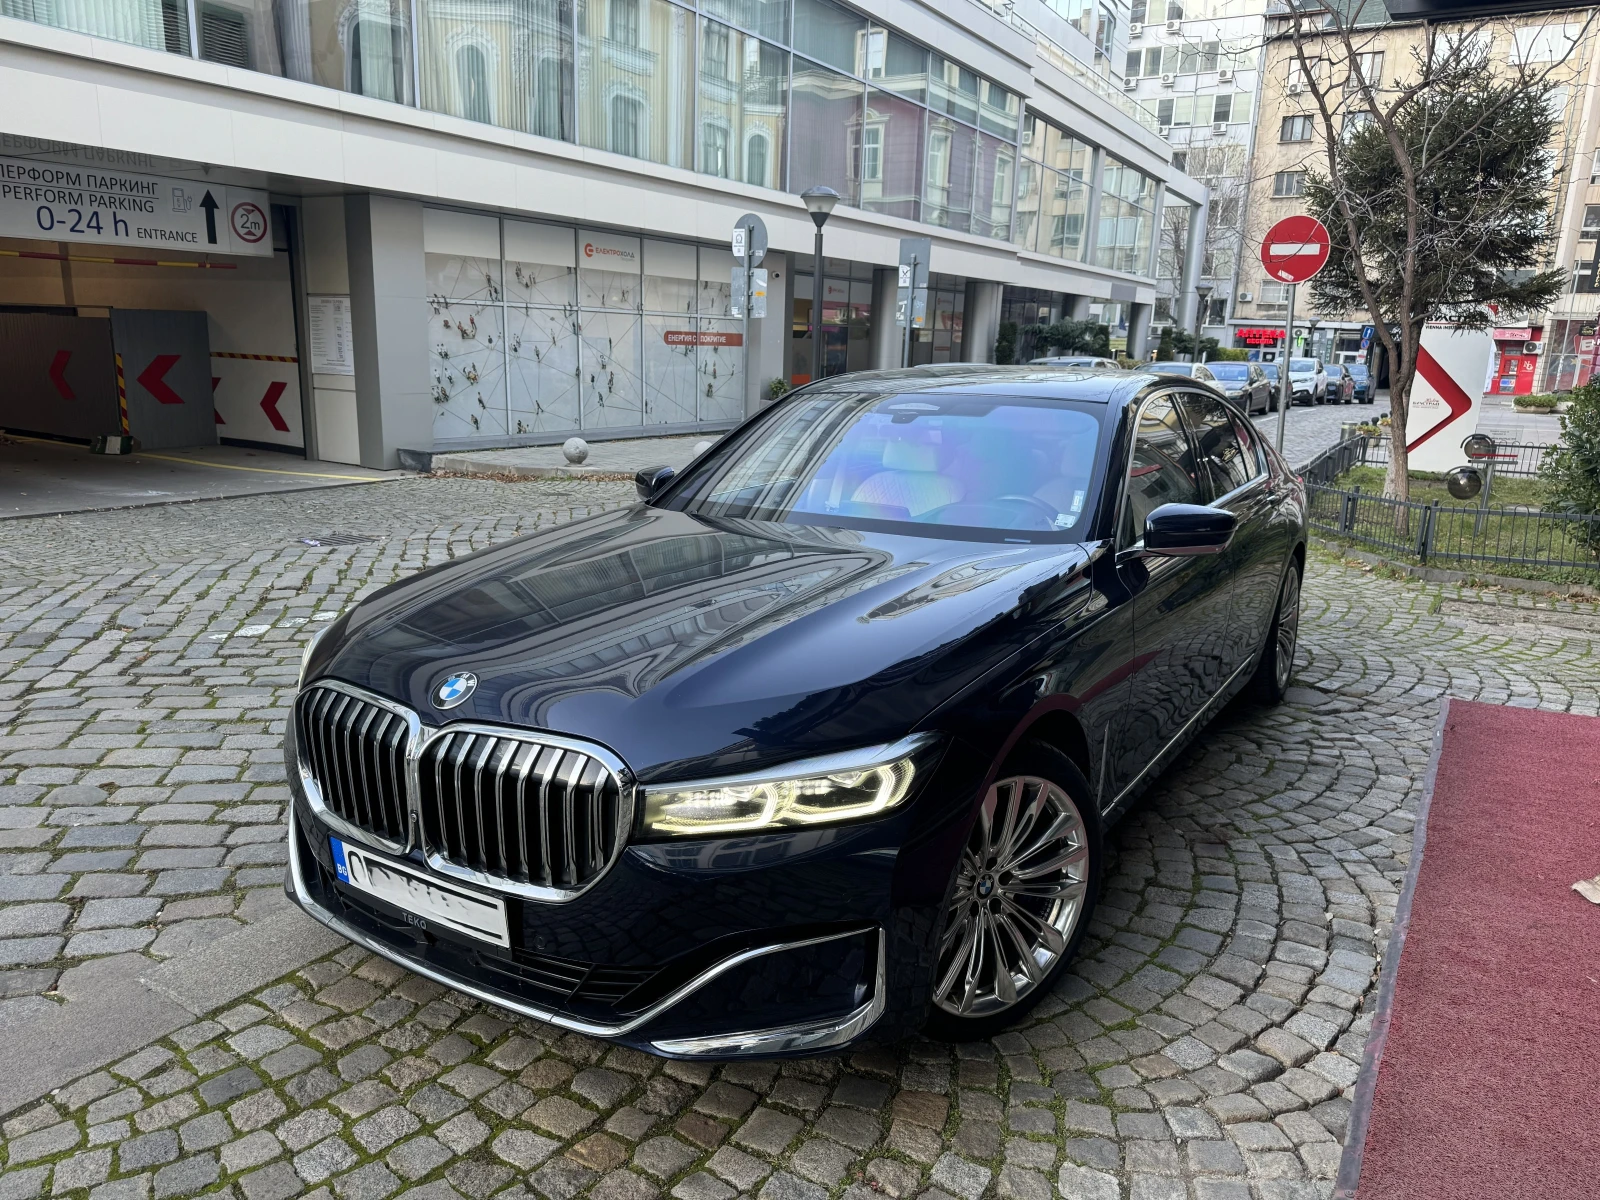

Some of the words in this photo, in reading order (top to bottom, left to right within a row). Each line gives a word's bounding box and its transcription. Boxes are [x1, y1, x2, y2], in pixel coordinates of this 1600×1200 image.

[87, 174, 159, 196] ПАРКИНГ
[2, 184, 83, 206] PERFORM
[89, 193, 155, 213] PARKING
[36, 205, 104, 235] 0-24
[112, 210, 129, 238] h
[240, 213, 261, 231] 2m
[137, 227, 198, 243] ENTRANCE
[668, 334, 692, 342] ЕНЕРГИЯ
[700, 335, 727, 343] ПОКРИТИЕ
[337, 863, 348, 876] BG
[402, 911, 428, 930] TEKO
